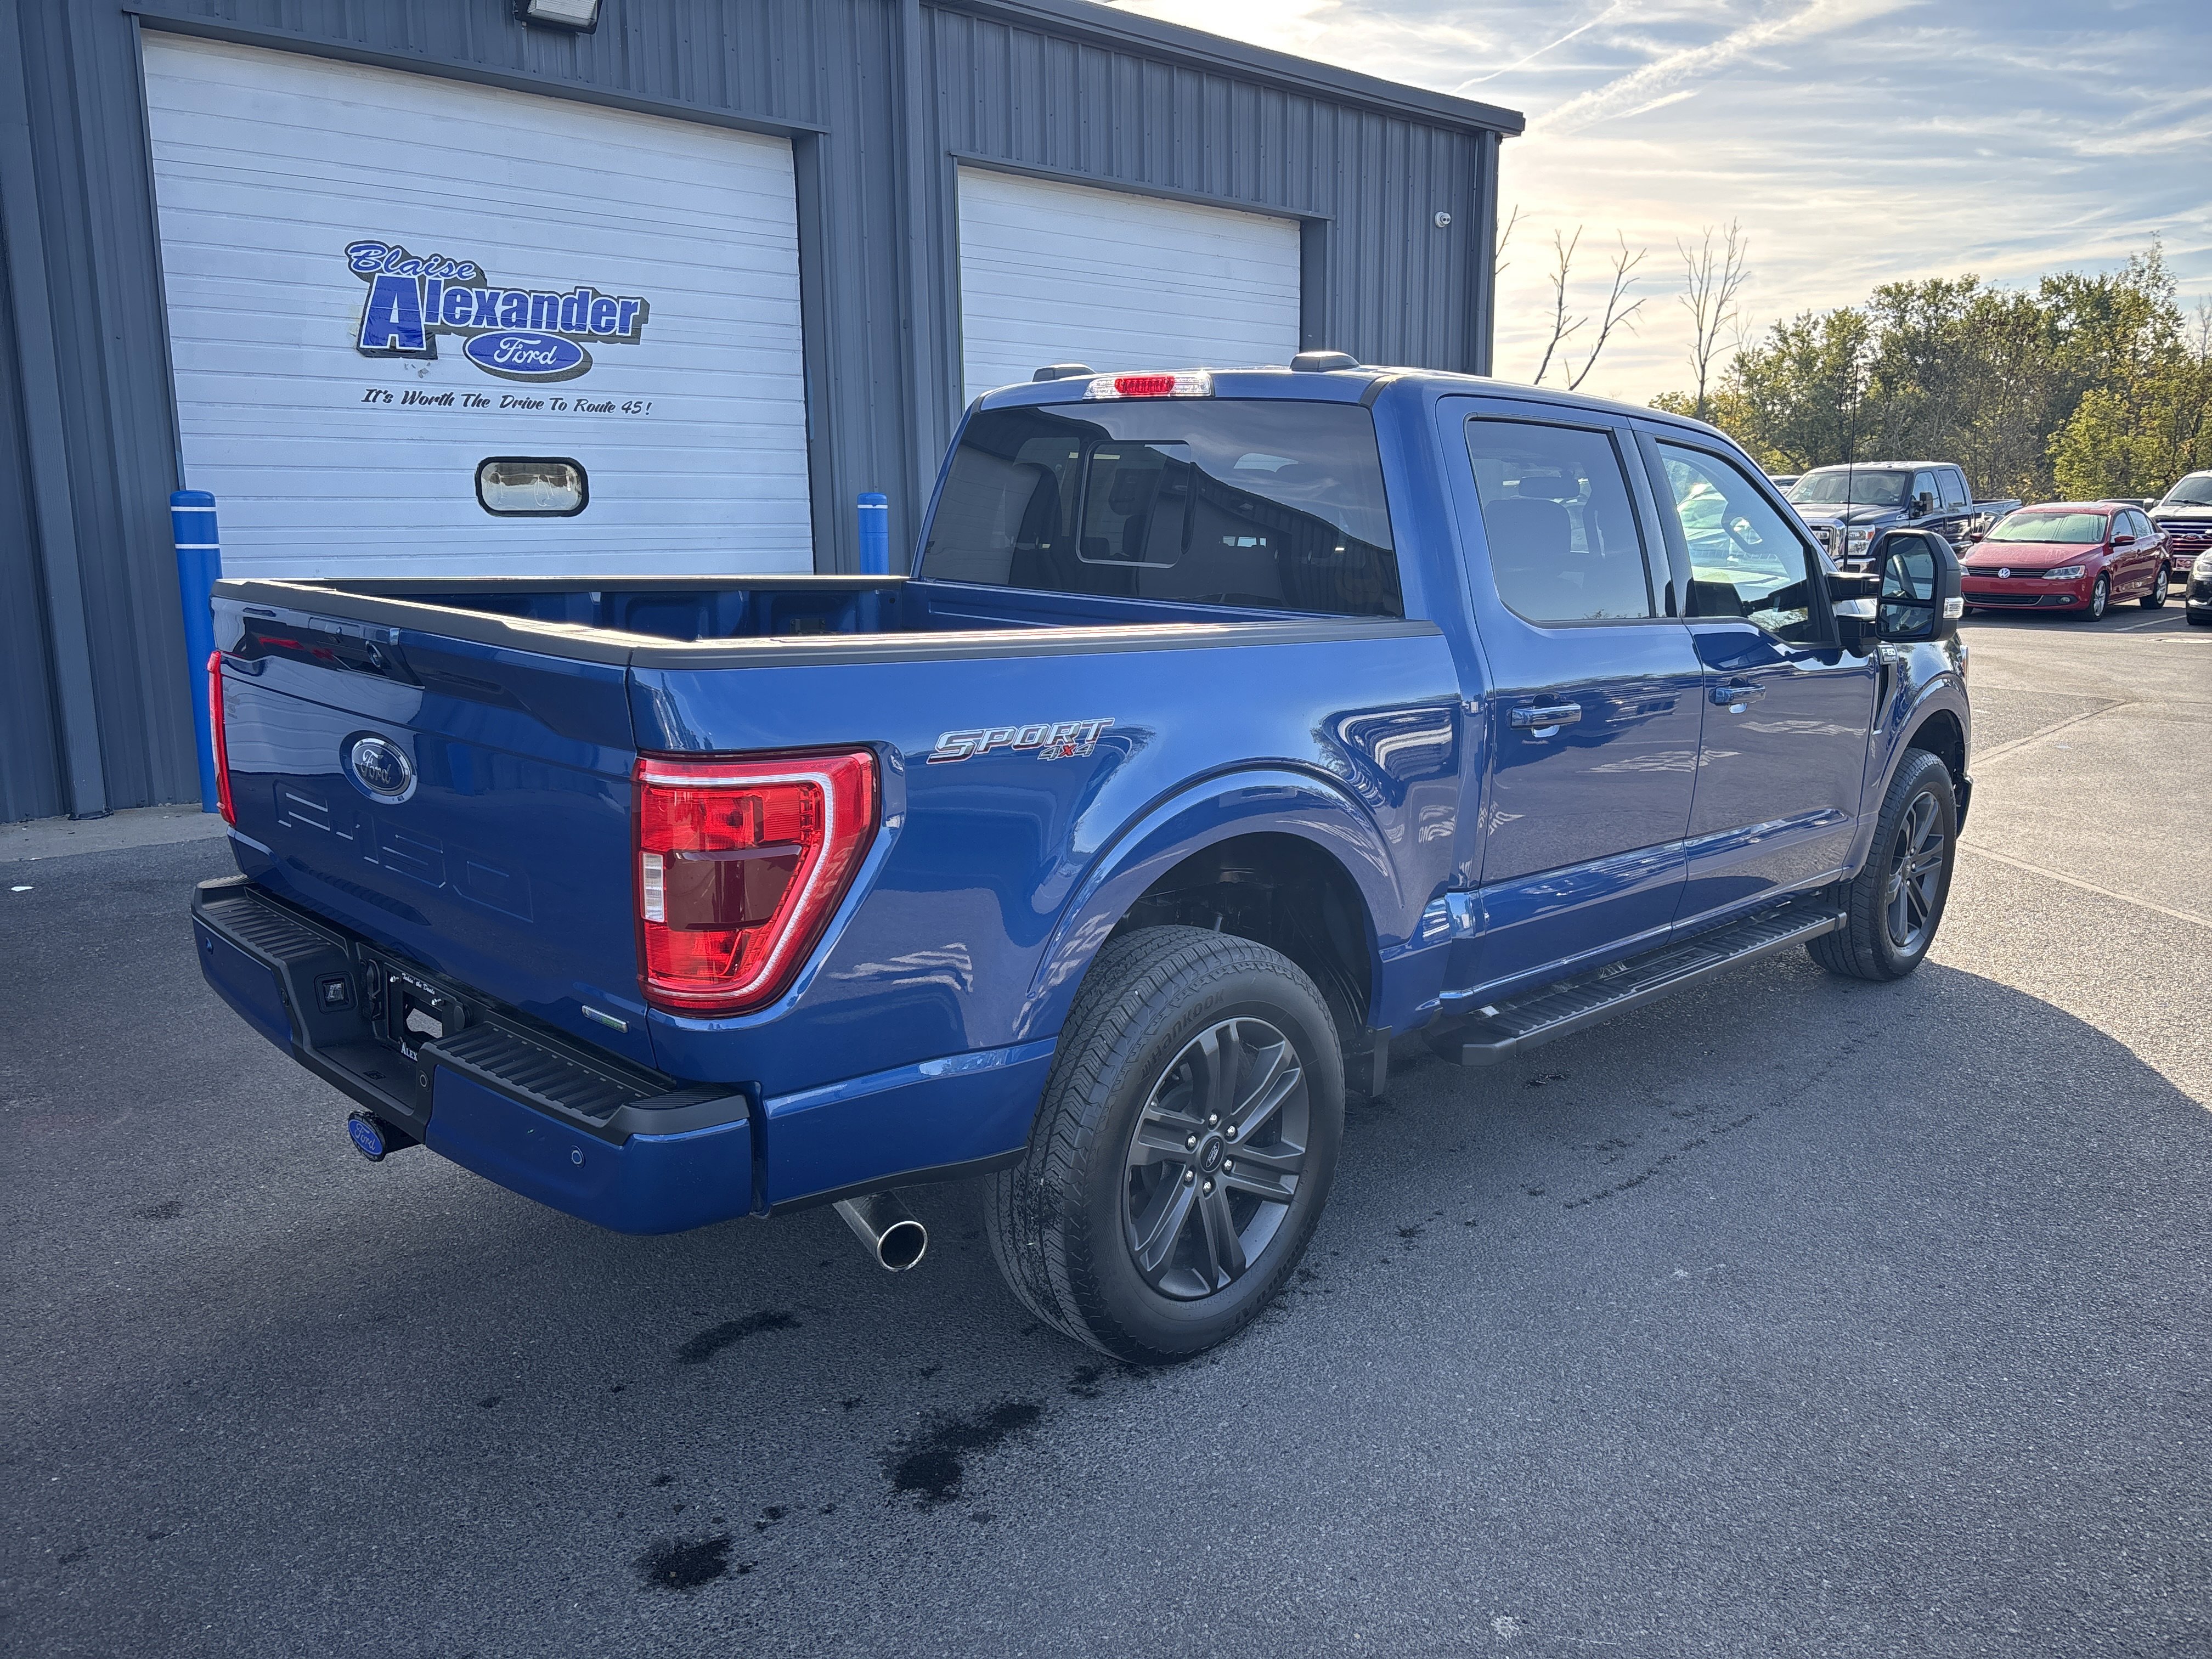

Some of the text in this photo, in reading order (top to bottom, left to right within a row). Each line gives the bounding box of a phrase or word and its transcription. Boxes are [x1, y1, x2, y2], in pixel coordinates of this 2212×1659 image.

[346, 242, 477, 281] Blaise
[359, 273, 641, 351] Alexander
[493, 336, 558, 365] Ford
[360, 388, 394, 404] It's
[400, 390, 455, 407] Worth
[460, 393, 491, 408] The
[499, 394, 545, 410] Drive
[549, 397, 568, 411] To
[573, 398, 616, 414] Route
[926, 717, 1115, 765] SPORT
[361, 749, 391, 785] Ford
[400, 1042, 419, 1062] ALEX
[354, 1122, 377, 1150] Ford
